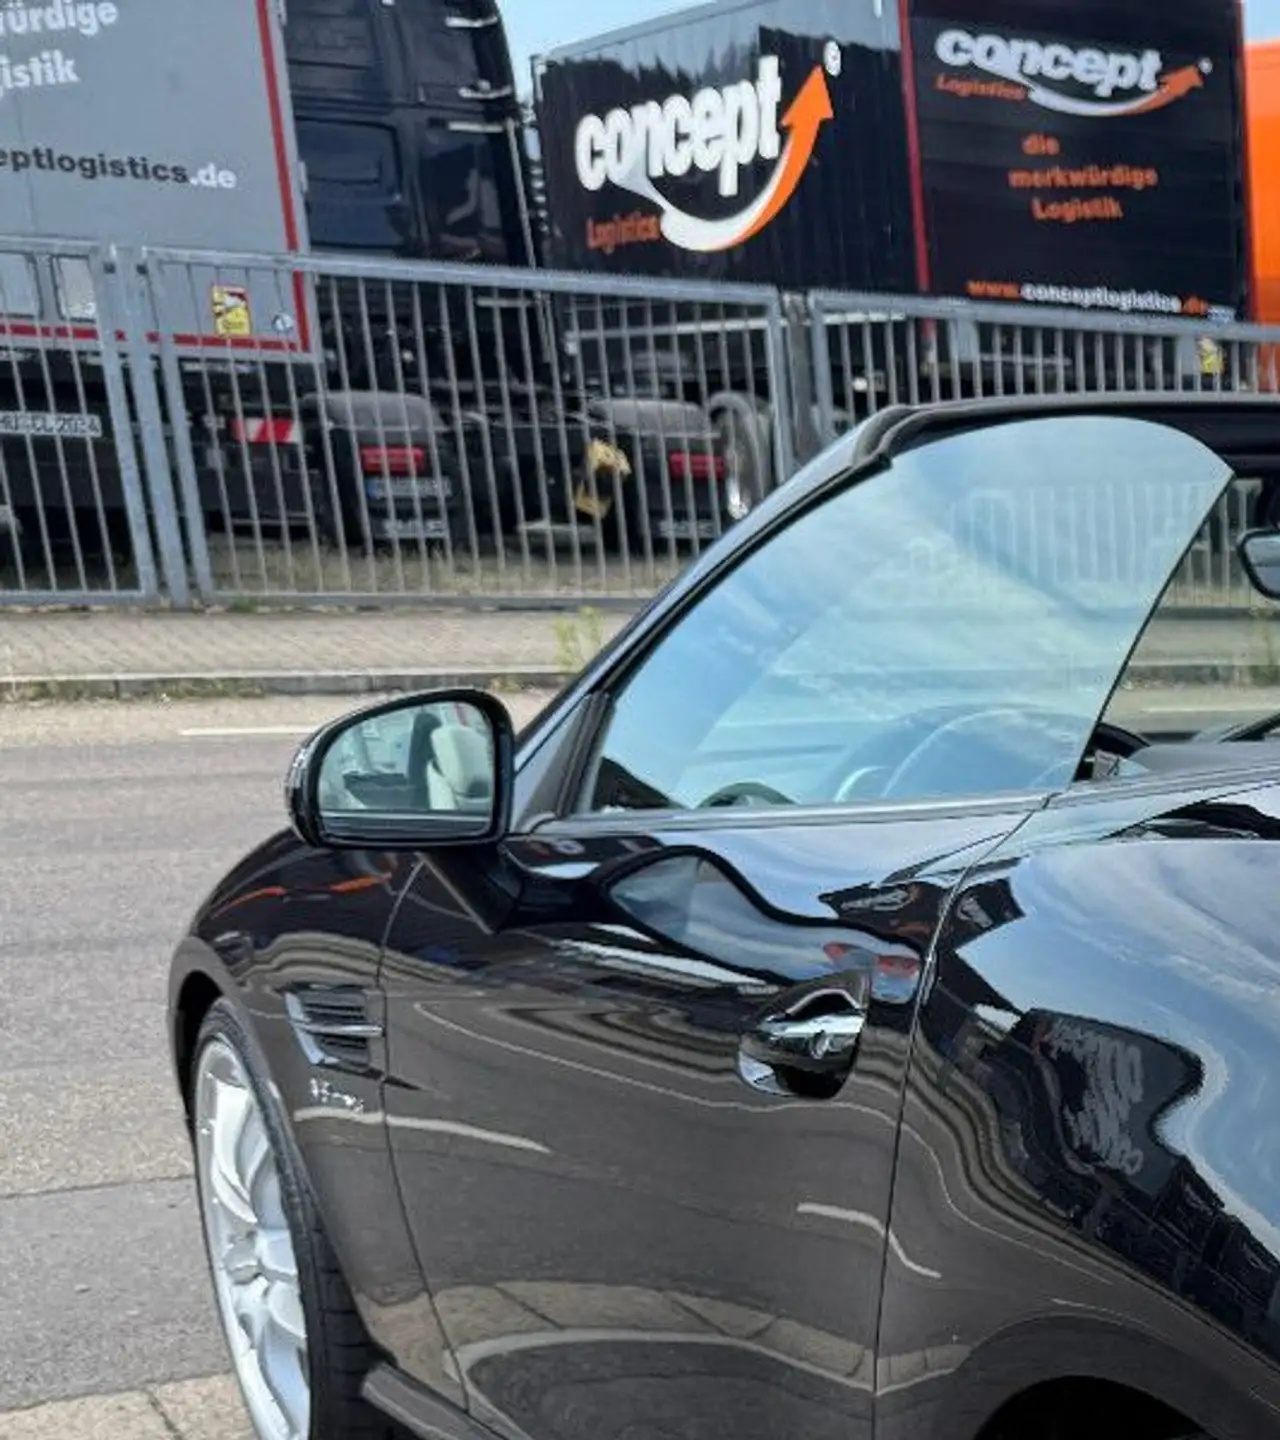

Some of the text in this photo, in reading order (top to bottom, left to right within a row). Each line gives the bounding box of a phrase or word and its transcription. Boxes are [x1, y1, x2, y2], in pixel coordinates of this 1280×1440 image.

[0, 0, 118, 36] ürdige
[0, 50, 80, 97] istik
[935, 29, 1162, 97] concept
[935, 73, 1027, 101] Logistics
[576, 55, 782, 197] concept
[1021, 132, 1060, 156] die
[1008, 165, 1159, 191] merkwürdige
[1031, 195, 1123, 222] Logistik
[585, 211, 661, 254] Logistics
